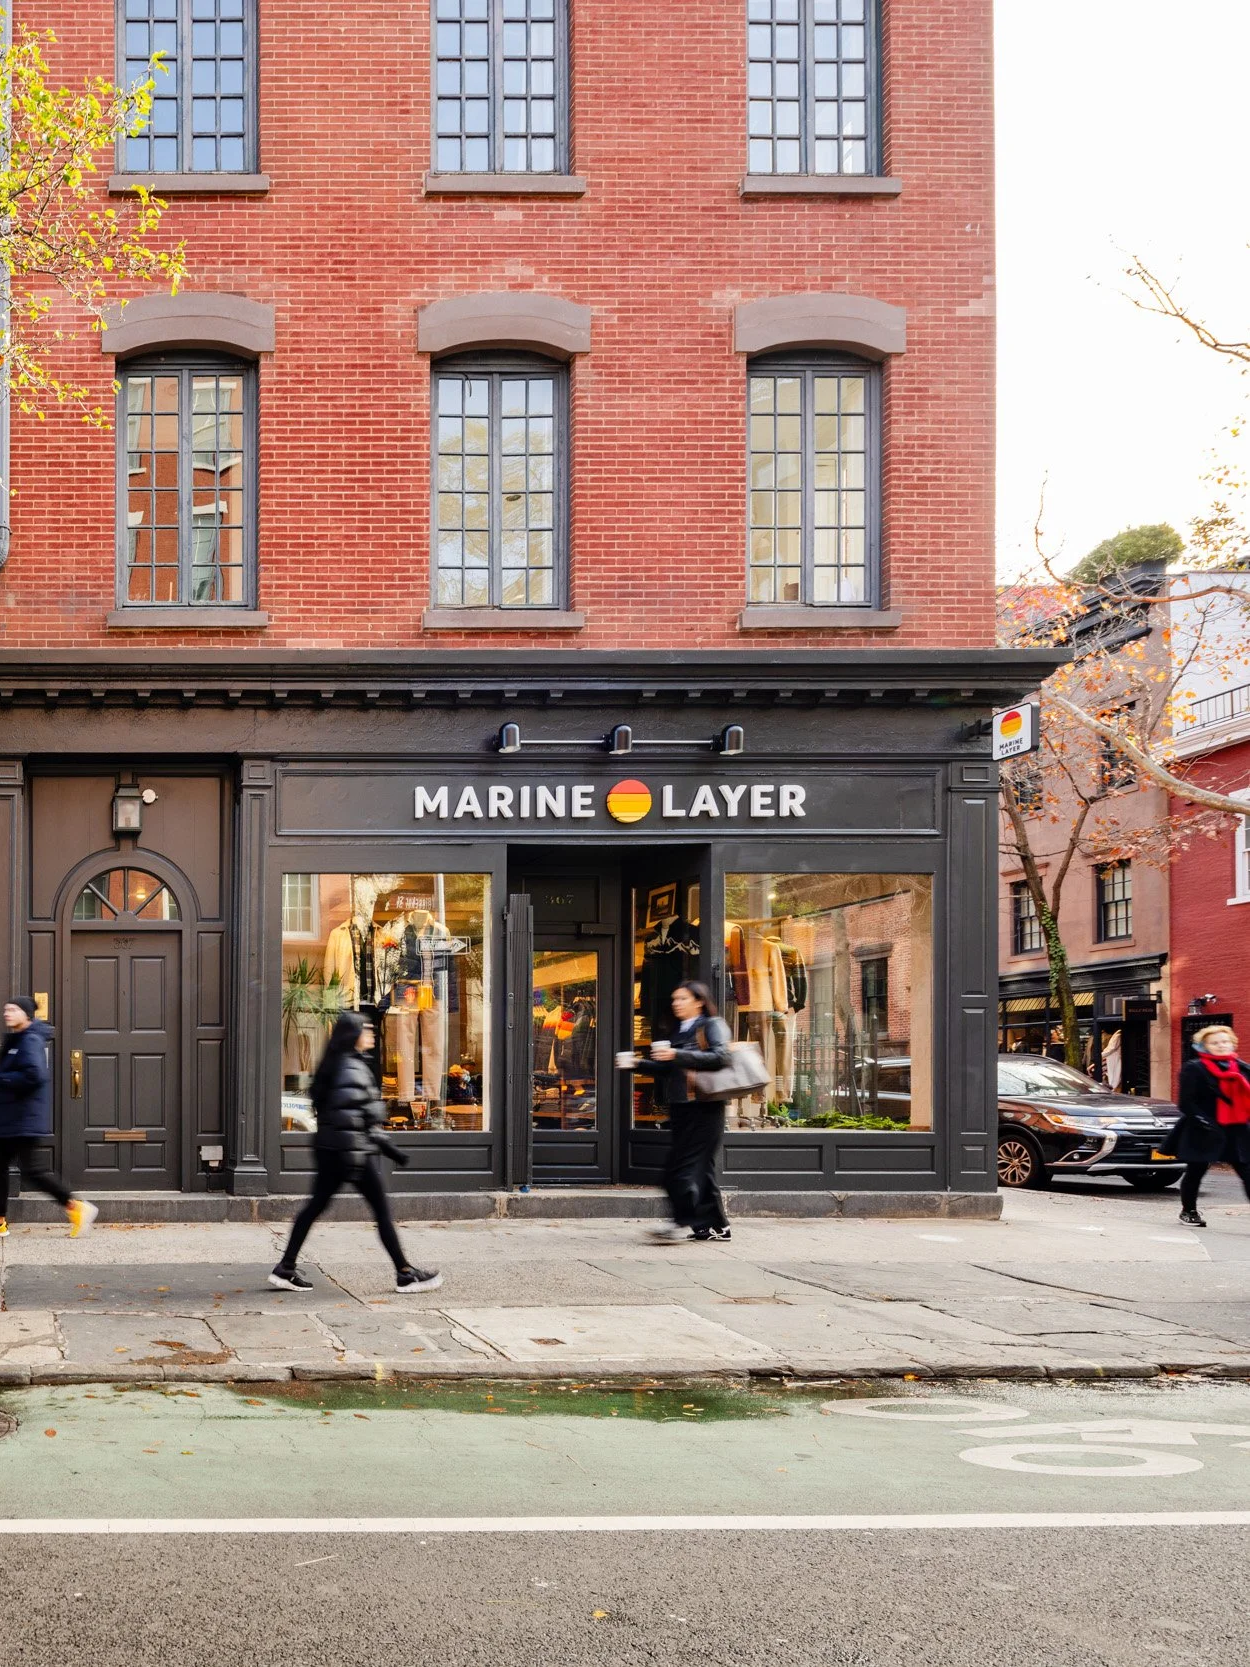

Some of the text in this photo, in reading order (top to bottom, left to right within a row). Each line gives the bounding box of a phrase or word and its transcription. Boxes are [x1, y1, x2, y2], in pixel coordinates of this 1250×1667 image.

[999, 737, 1024, 751] MARINE
[1001, 745, 1021, 756] LAYER
[414, 784, 807, 820] MARINE LAYER
